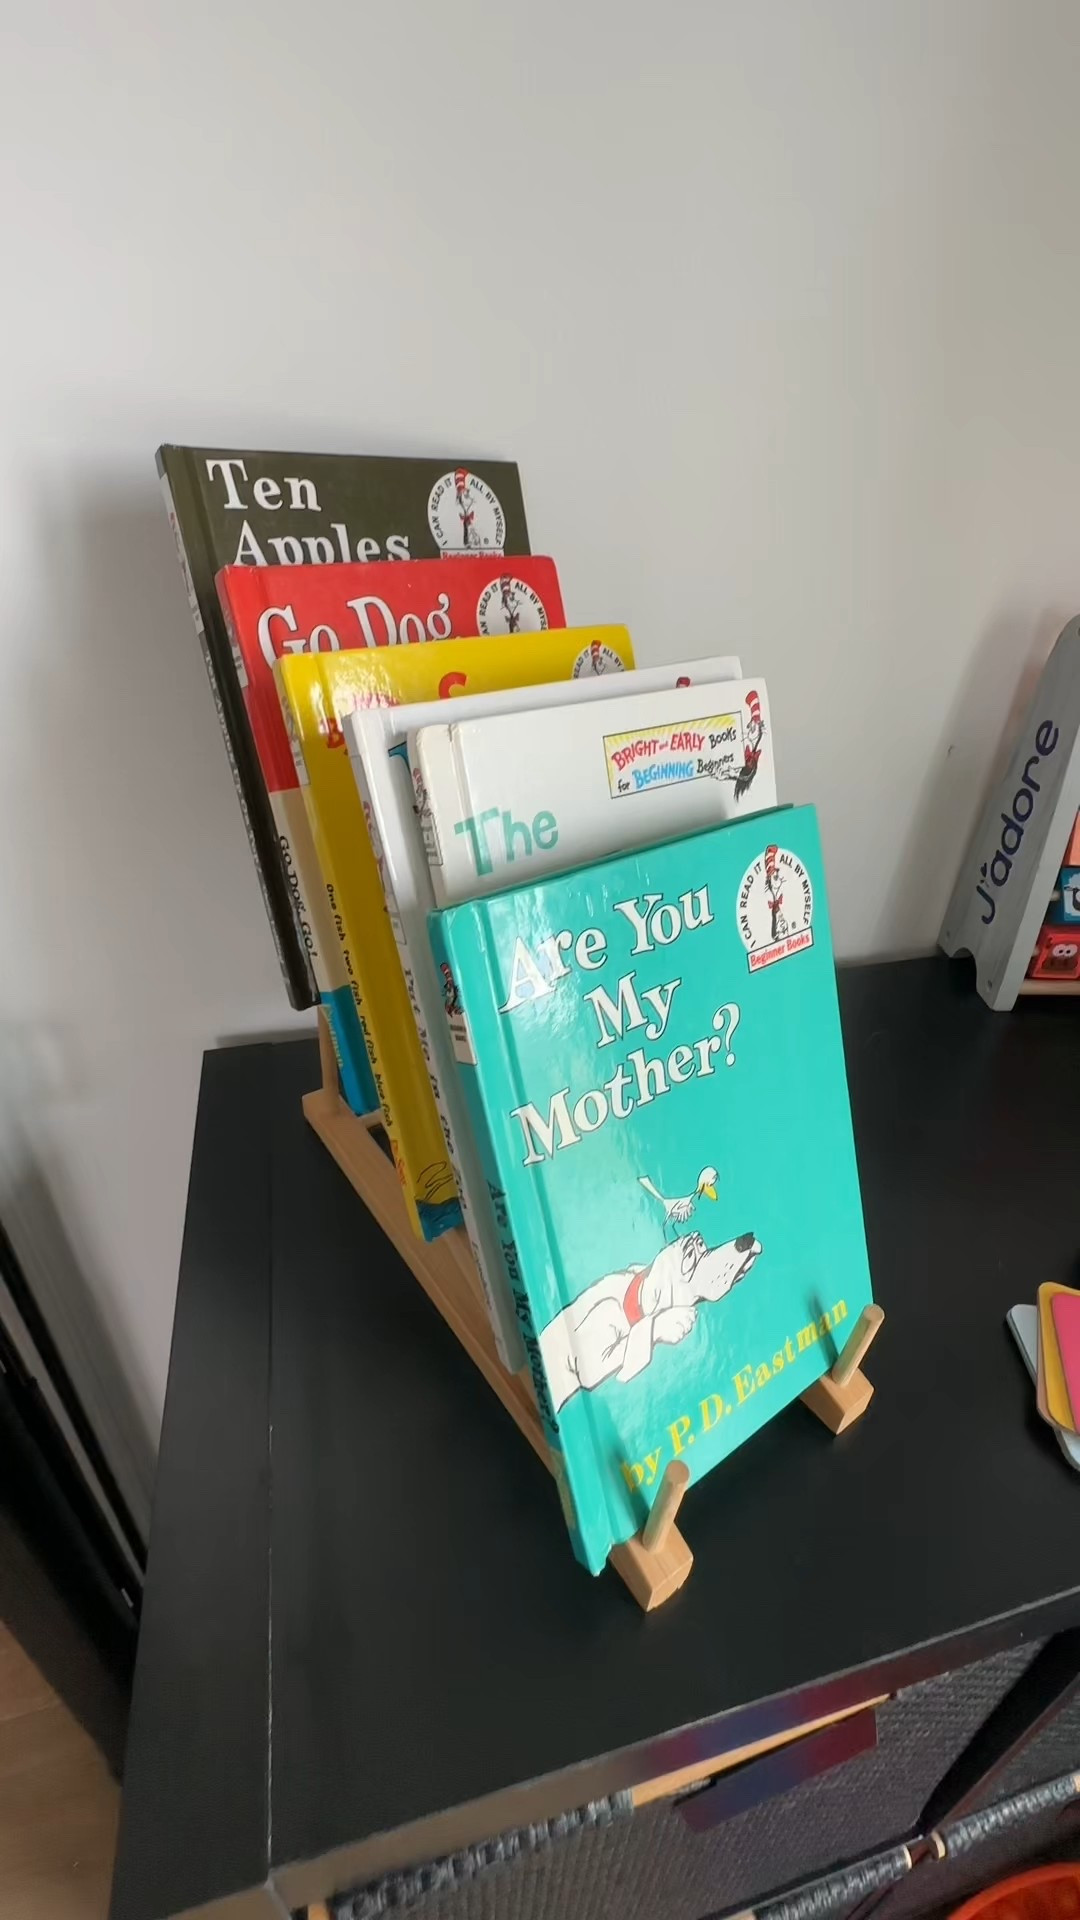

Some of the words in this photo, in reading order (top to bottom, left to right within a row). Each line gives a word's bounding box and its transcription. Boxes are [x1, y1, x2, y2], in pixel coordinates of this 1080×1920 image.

[206, 459, 322, 512] Ten
[431, 484, 445, 512] READ
[444, 477, 453, 488] IT
[431, 516, 444, 539] CAN
[469, 478, 484, 494] ALL
[485, 491, 496, 505] BY
[493, 506, 504, 546] MYSELF
[233, 519, 412, 567] Apples
[479, 590, 492, 616] READ
[490, 582, 499, 593] IT
[514, 581, 528, 595] ALL
[529, 593, 539, 604] BY
[257, 604, 342, 671] Go
[602, 647, 614, 658] ALL
[611, 739, 659, 771] BRIGHT
[669, 732, 705, 753] EARLY
[708, 726, 737, 749] Books
[617, 779, 630, 793] for
[632, 760, 694, 790] BEGINNING
[696, 753, 735, 775] Beginners
[454, 807, 559, 877] The
[976, 719, 1060, 924] J'adore
[280, 835, 292, 865] Go
[753, 861, 763, 875] IT
[740, 875, 754, 908] READ
[779, 854, 793, 868] ALL
[794, 864, 805, 878] BY
[801, 879, 812, 925] MYSELF
[497, 926, 608, 1015] Are
[613, 884, 715, 956] You
[740, 915, 752, 940] CAN
[750, 945, 785, 967] Beginner
[786, 934, 810, 949] Books
[326, 883, 338, 911] One
[334, 914, 346, 941] fish
[343, 949, 354, 976] two
[351, 980, 363, 1006] fish
[366, 1038, 377, 1065] fish
[381, 1102, 394, 1128] fish
[583, 970, 682, 1048] My
[510, 1002, 741, 1167] Mother?
[486, 1178, 510, 1229] Are
[500, 1239, 521, 1281] You
[512, 1288, 534, 1329] My
[522, 1331, 560, 1435] Mother?
[619, 1448, 662, 1492] by
[666, 1415, 696, 1456] P.
[699, 1393, 733, 1432] D.
[730, 1299, 849, 1406] Eastman
